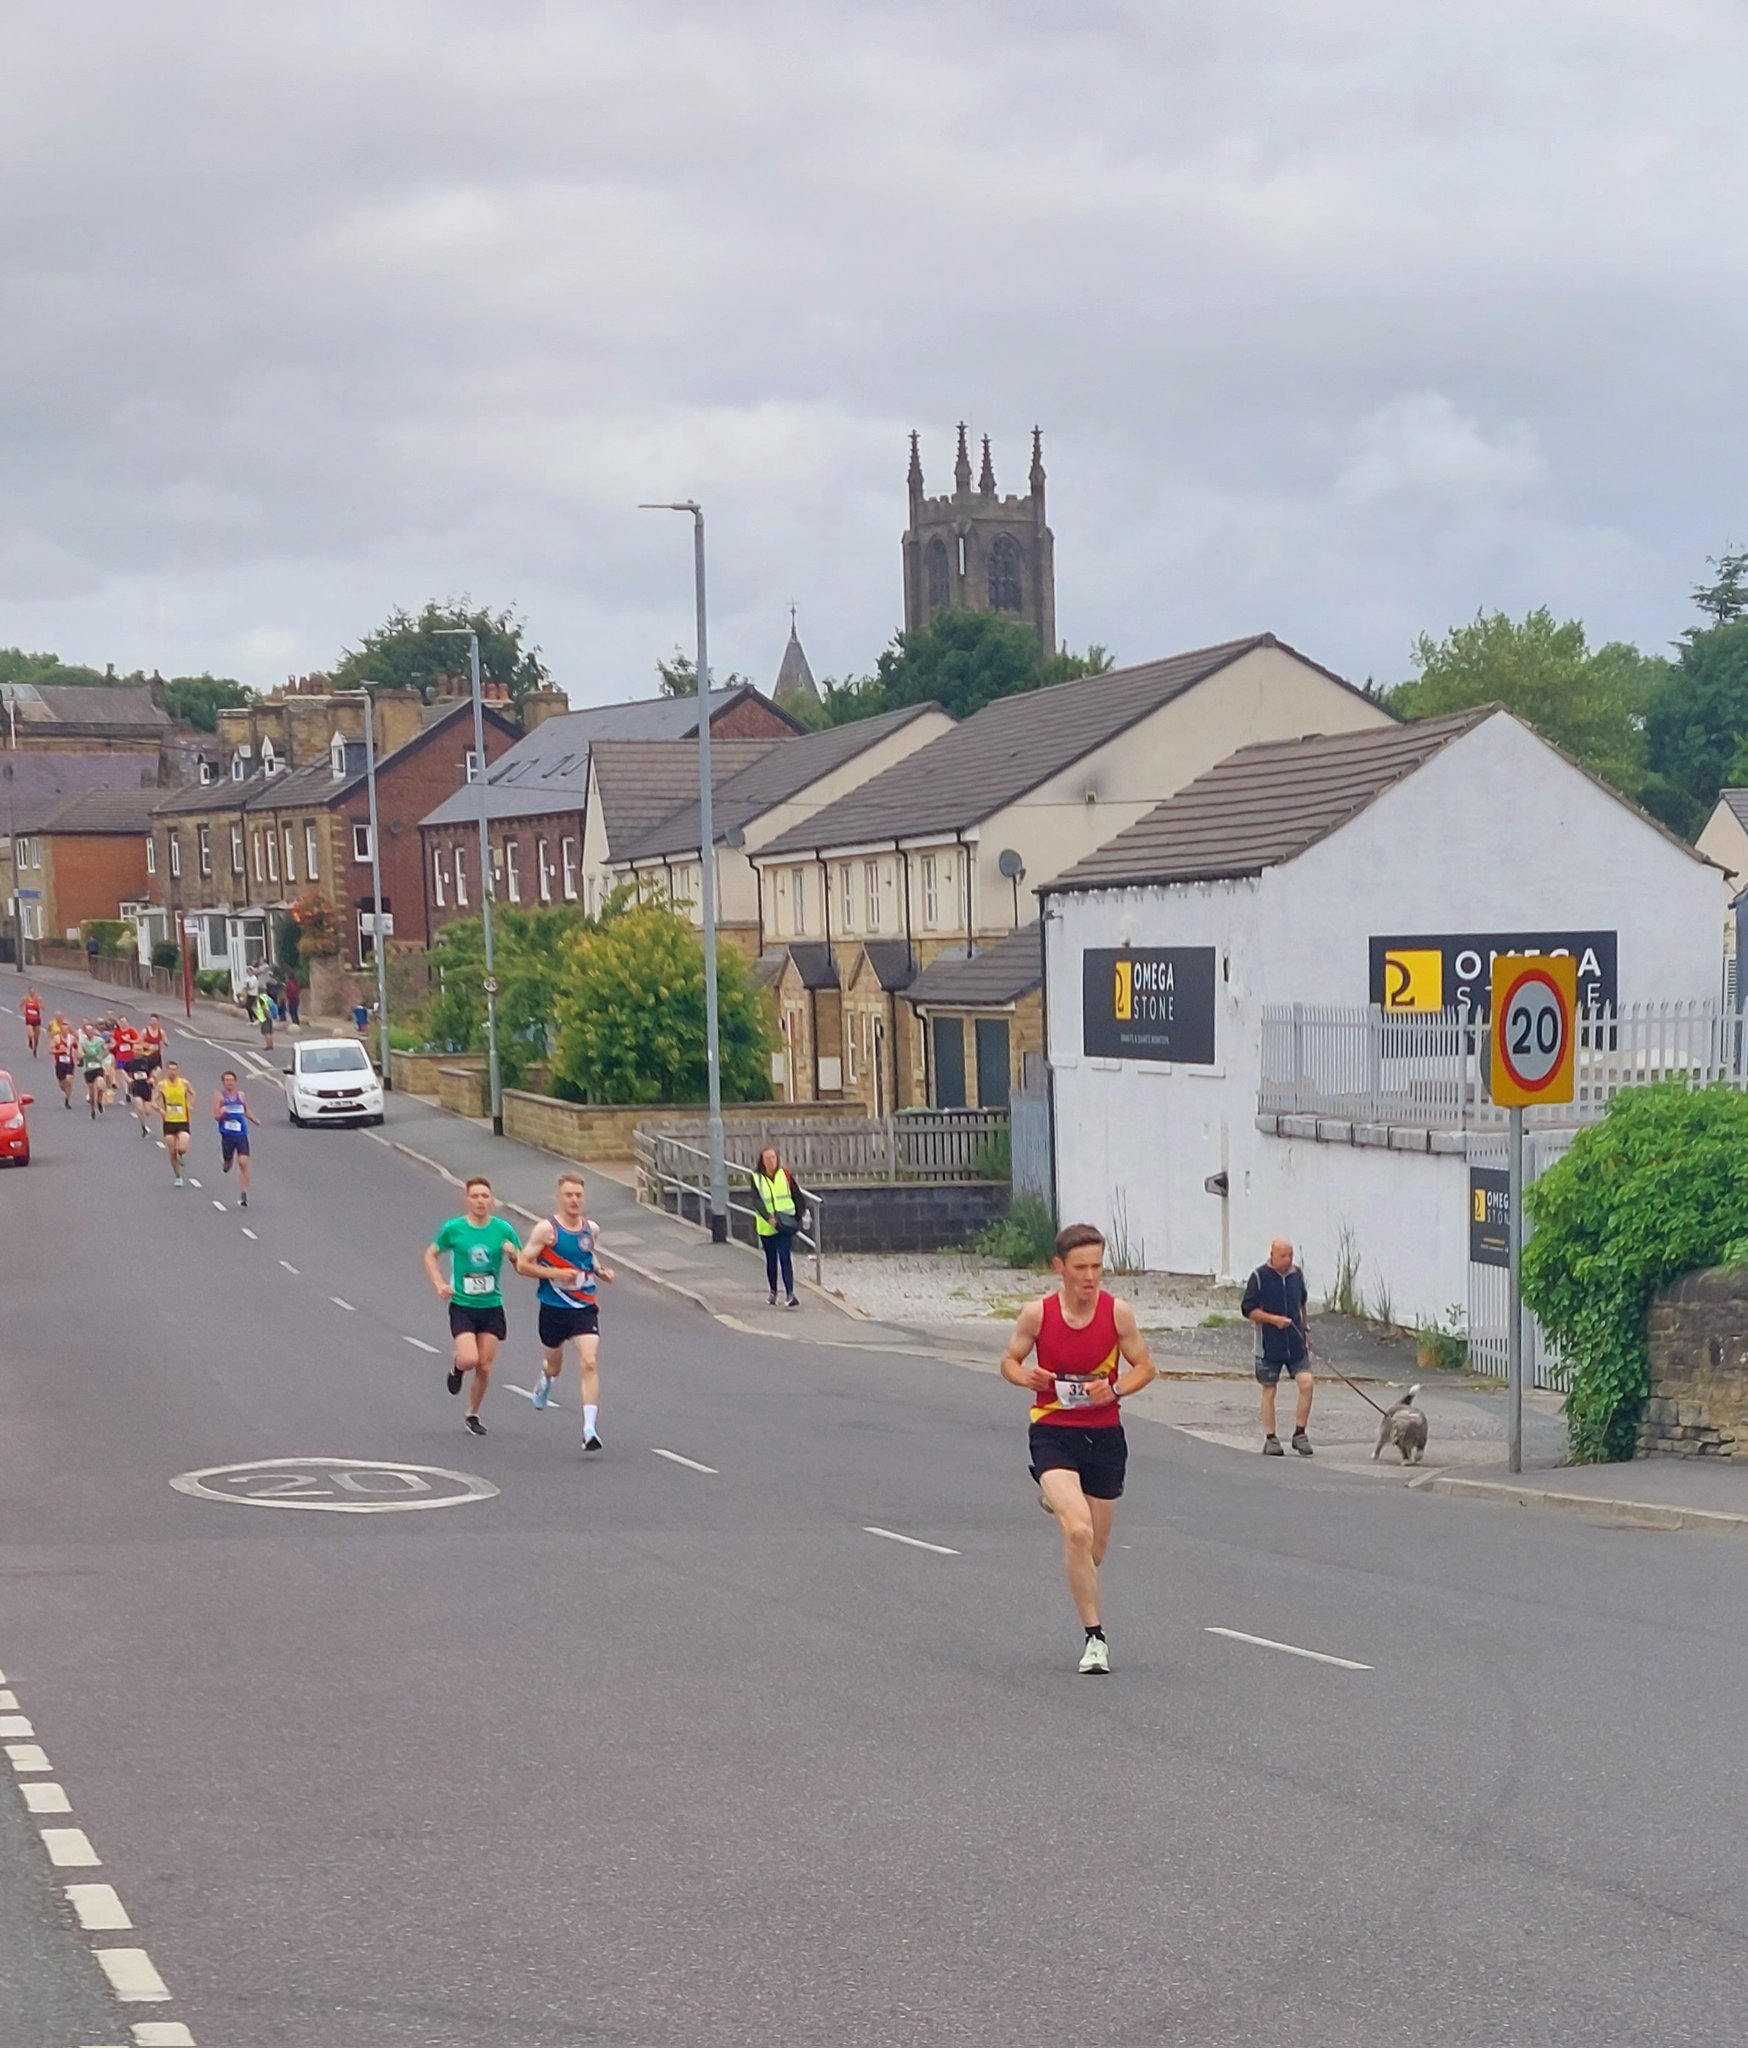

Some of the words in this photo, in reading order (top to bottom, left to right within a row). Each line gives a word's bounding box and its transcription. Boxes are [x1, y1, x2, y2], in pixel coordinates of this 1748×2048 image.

[1133, 962, 1174, 990] OMEGA
[1133, 995, 1174, 1020] STONE
[1511, 1006, 1559, 1055] 20
[1486, 1191, 1509, 1210] OMEG
[1486, 1209, 1510, 1225] STON
[229, 1472, 432, 1496] 20
